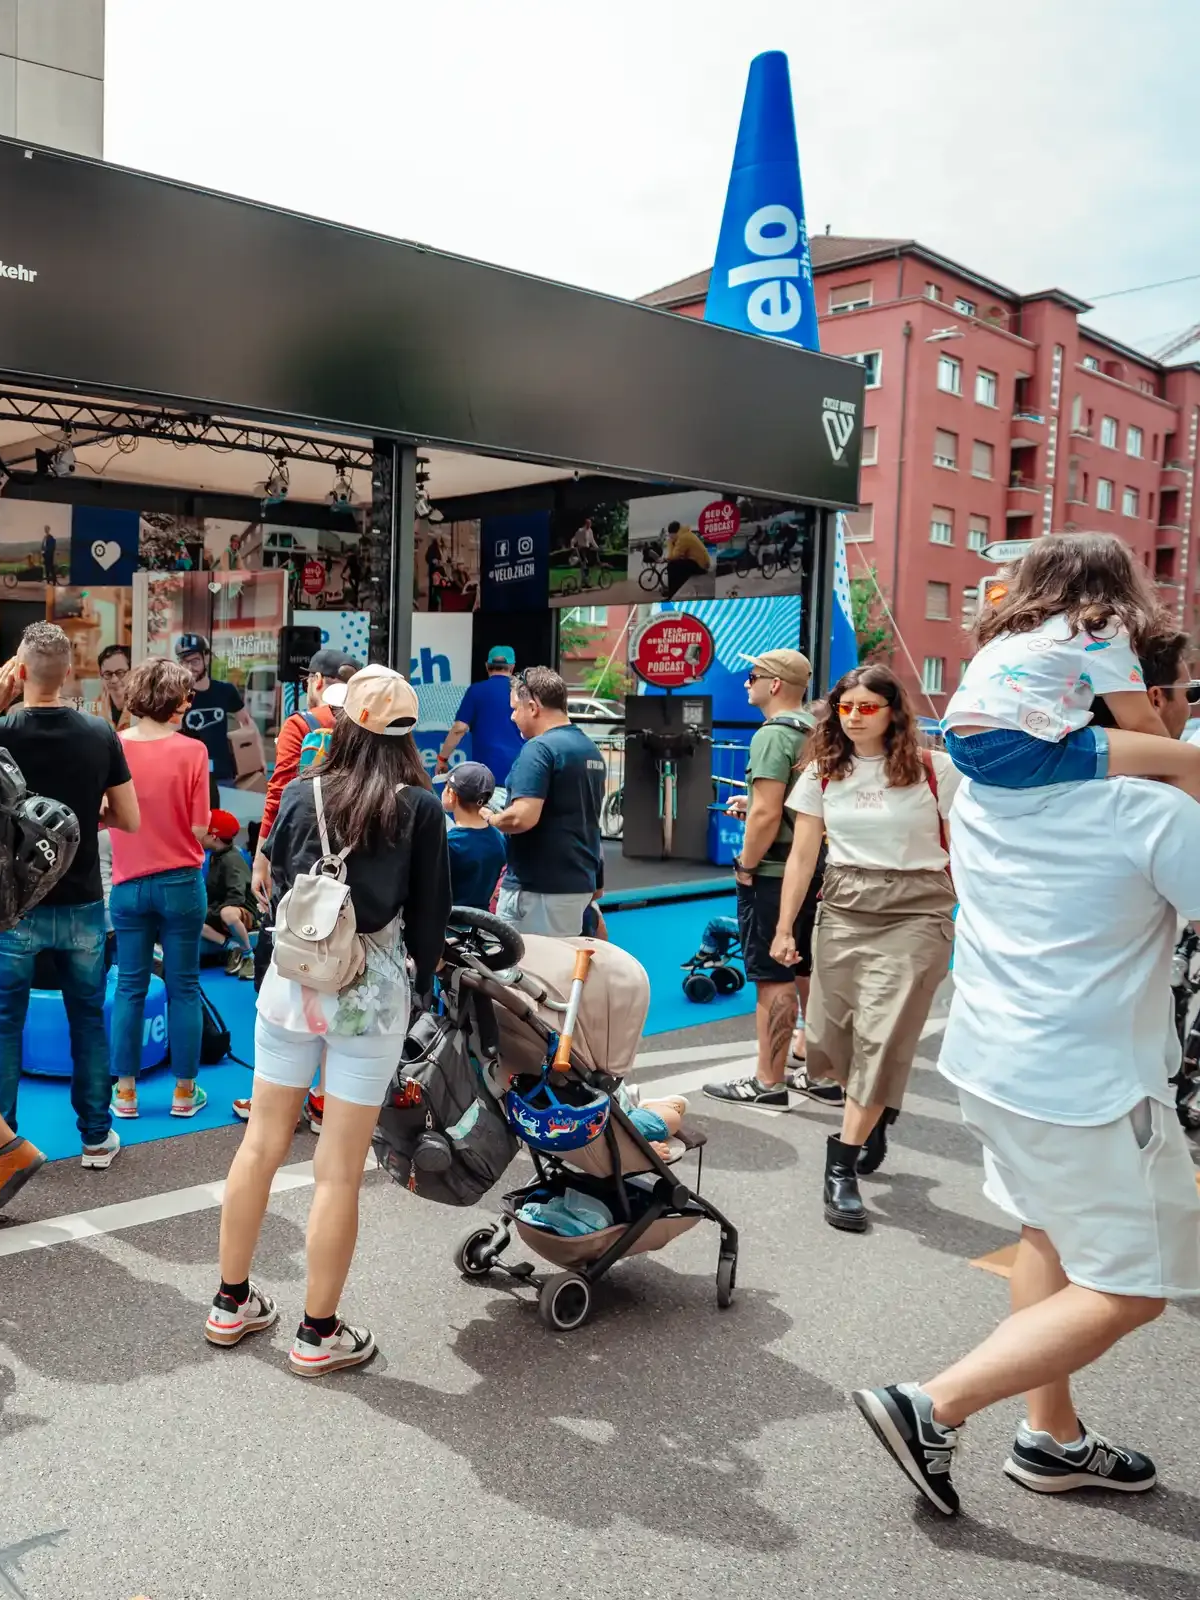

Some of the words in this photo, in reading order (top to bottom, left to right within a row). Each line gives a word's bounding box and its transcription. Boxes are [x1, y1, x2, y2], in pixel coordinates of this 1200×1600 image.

[728, 204, 803, 347] elo
[703, 519, 735, 534] PODCAST
[647, 661, 686, 673] PODCAST
[418, 743, 467, 768] eo
